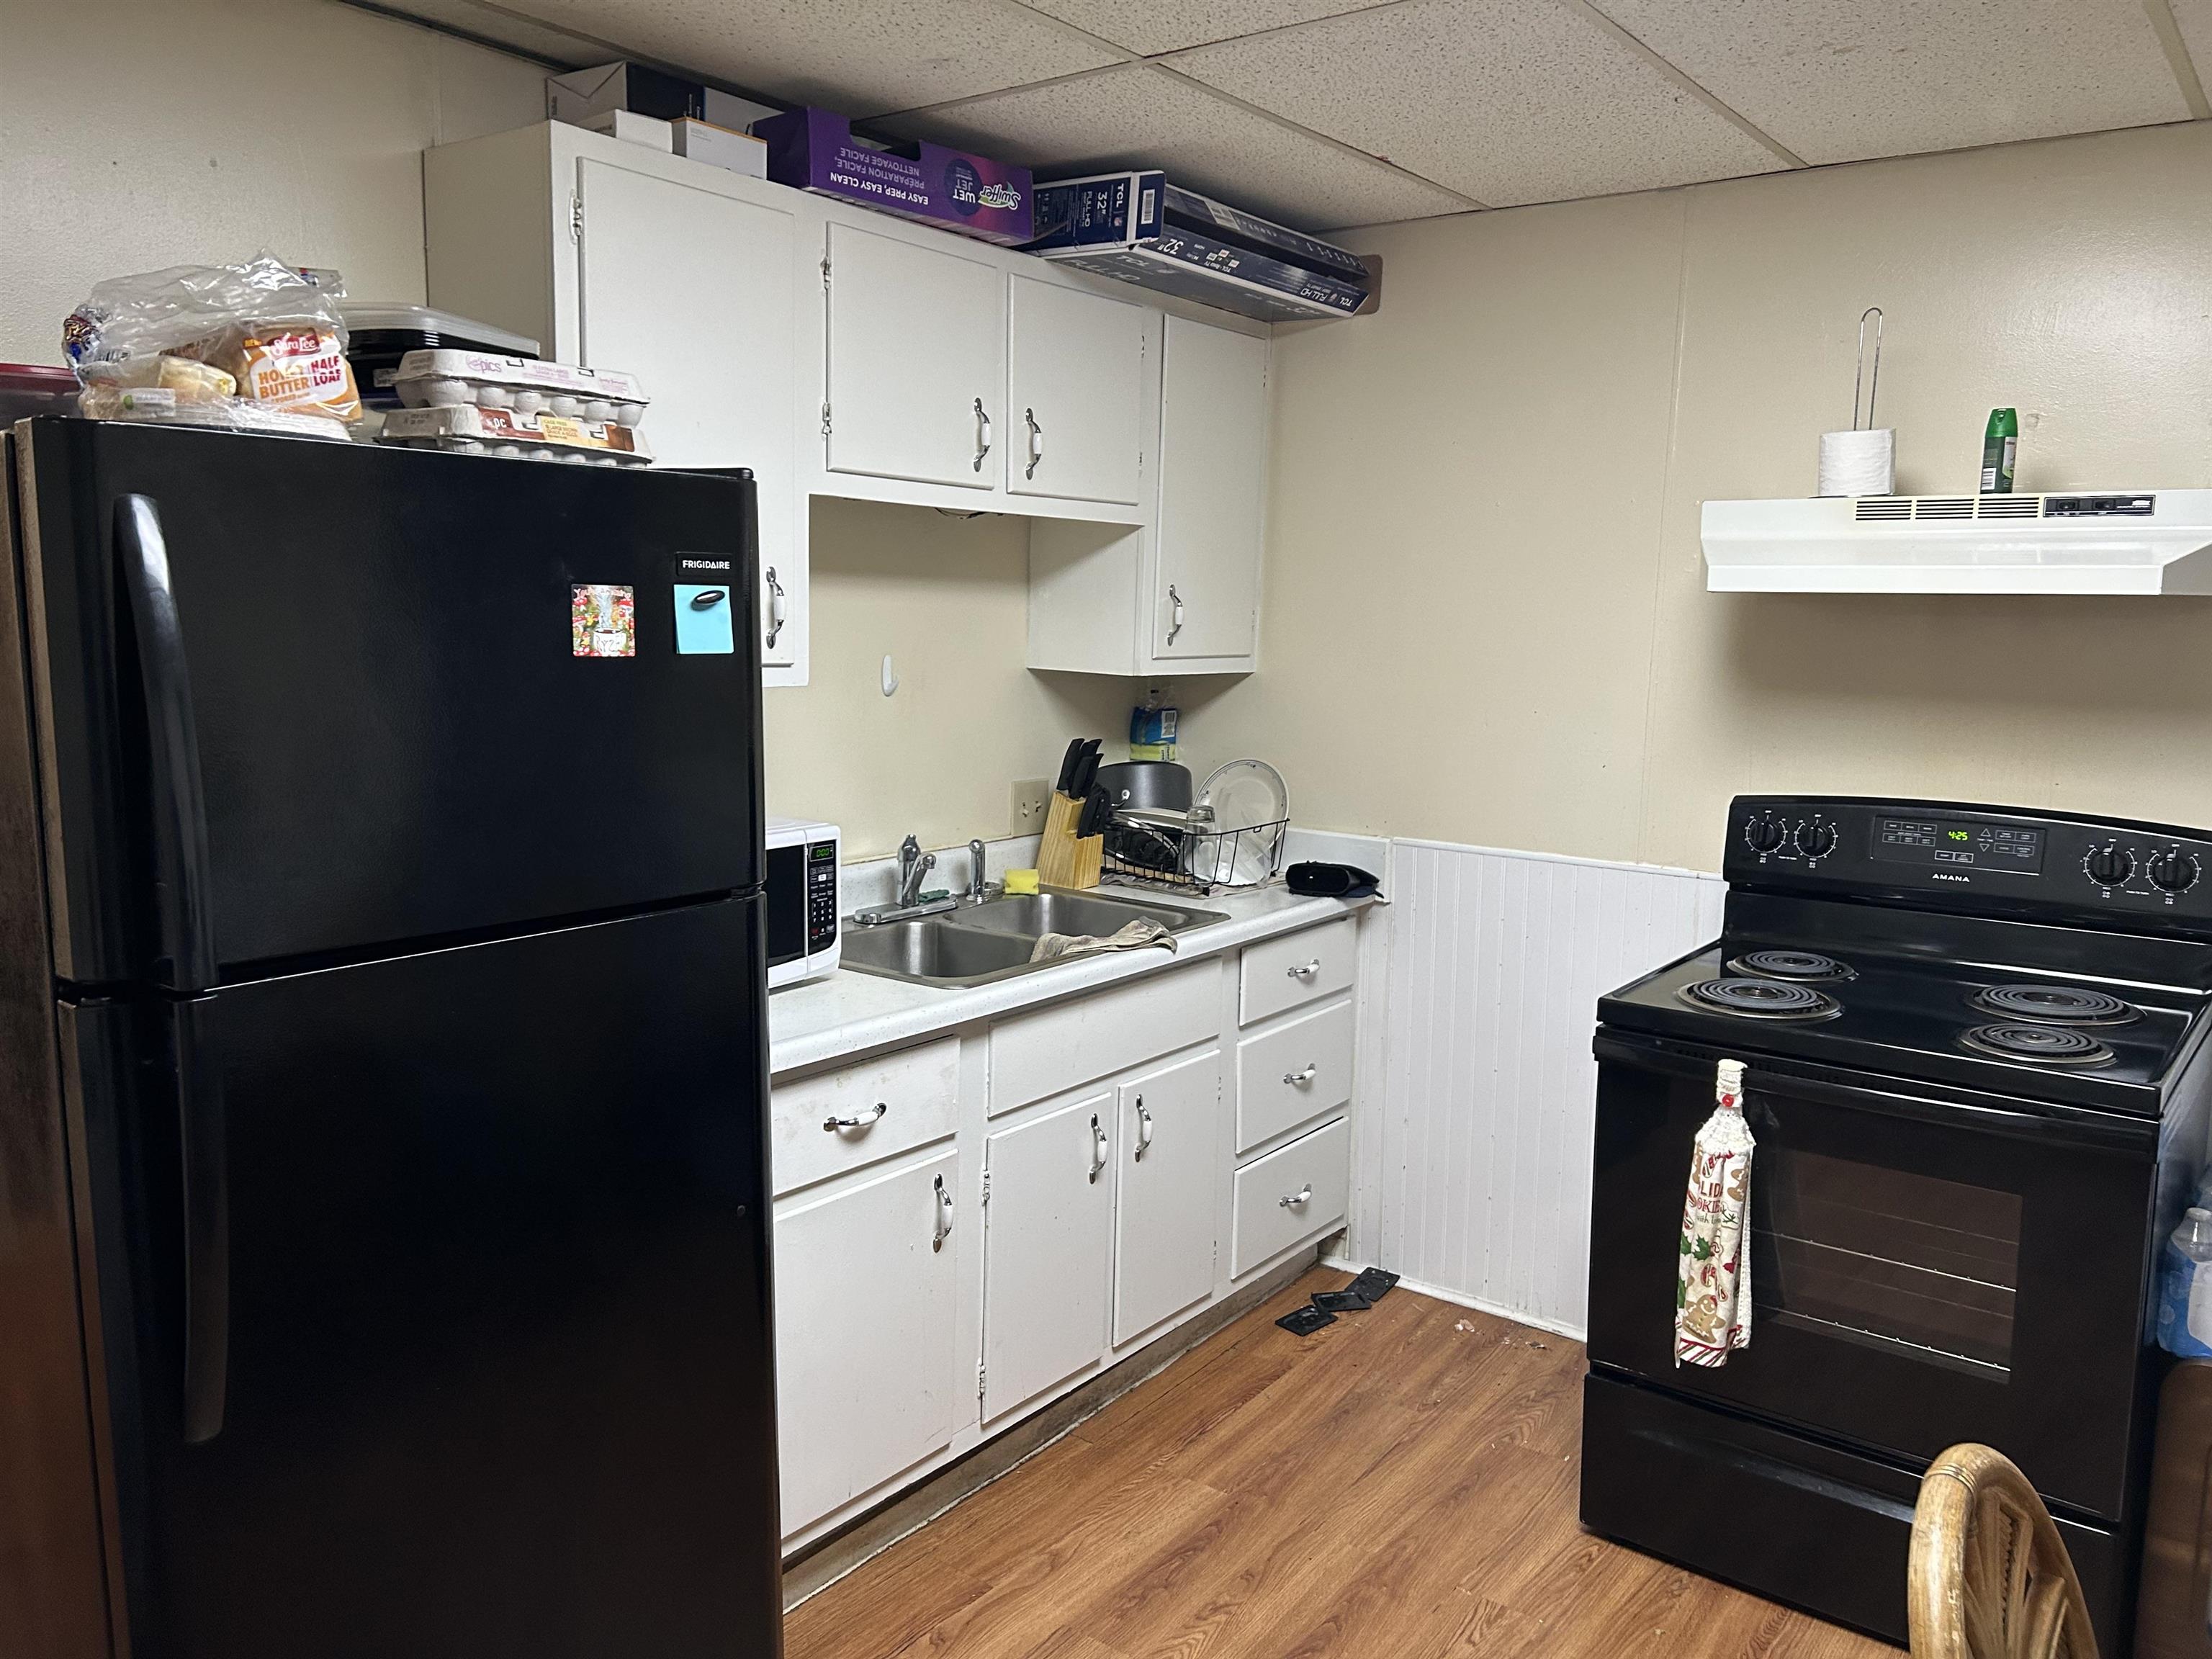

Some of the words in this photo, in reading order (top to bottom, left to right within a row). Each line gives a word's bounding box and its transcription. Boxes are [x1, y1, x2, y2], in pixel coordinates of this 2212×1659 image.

[840, 148, 870, 163] FACILE
[835, 156, 866, 174] FACILE,
[871, 156, 920, 176] NETTOYAGE
[830, 172, 859, 186] CLEAN
[868, 166, 925, 189] PRÉPARATION
[860, 180, 883, 194] EASY
[884, 184, 907, 199] PREP,
[956, 179, 973, 192] JET
[907, 192, 929, 205] EASY
[953, 189, 976, 203] WET
[979, 184, 1022, 210] Swiffer
[1116, 183, 1125, 208] TCL
[1097, 192, 1108, 215] 32"
[1084, 213, 1091, 228] HD
[1300, 287, 1313, 297] HD
[1313, 290, 1328, 302] FULL
[1340, 297, 1353, 307] TCL
[300, 337, 316, 351] Lee
[311, 356, 341, 373] HALF
[314, 369, 341, 387] LOAF
[258, 377, 310, 399] BUTTER
[683, 559, 730, 570] FRIGIDAIRE
[1948, 830, 1969, 841] 4:25
[1932, 873, 1970, 883] AMANA
